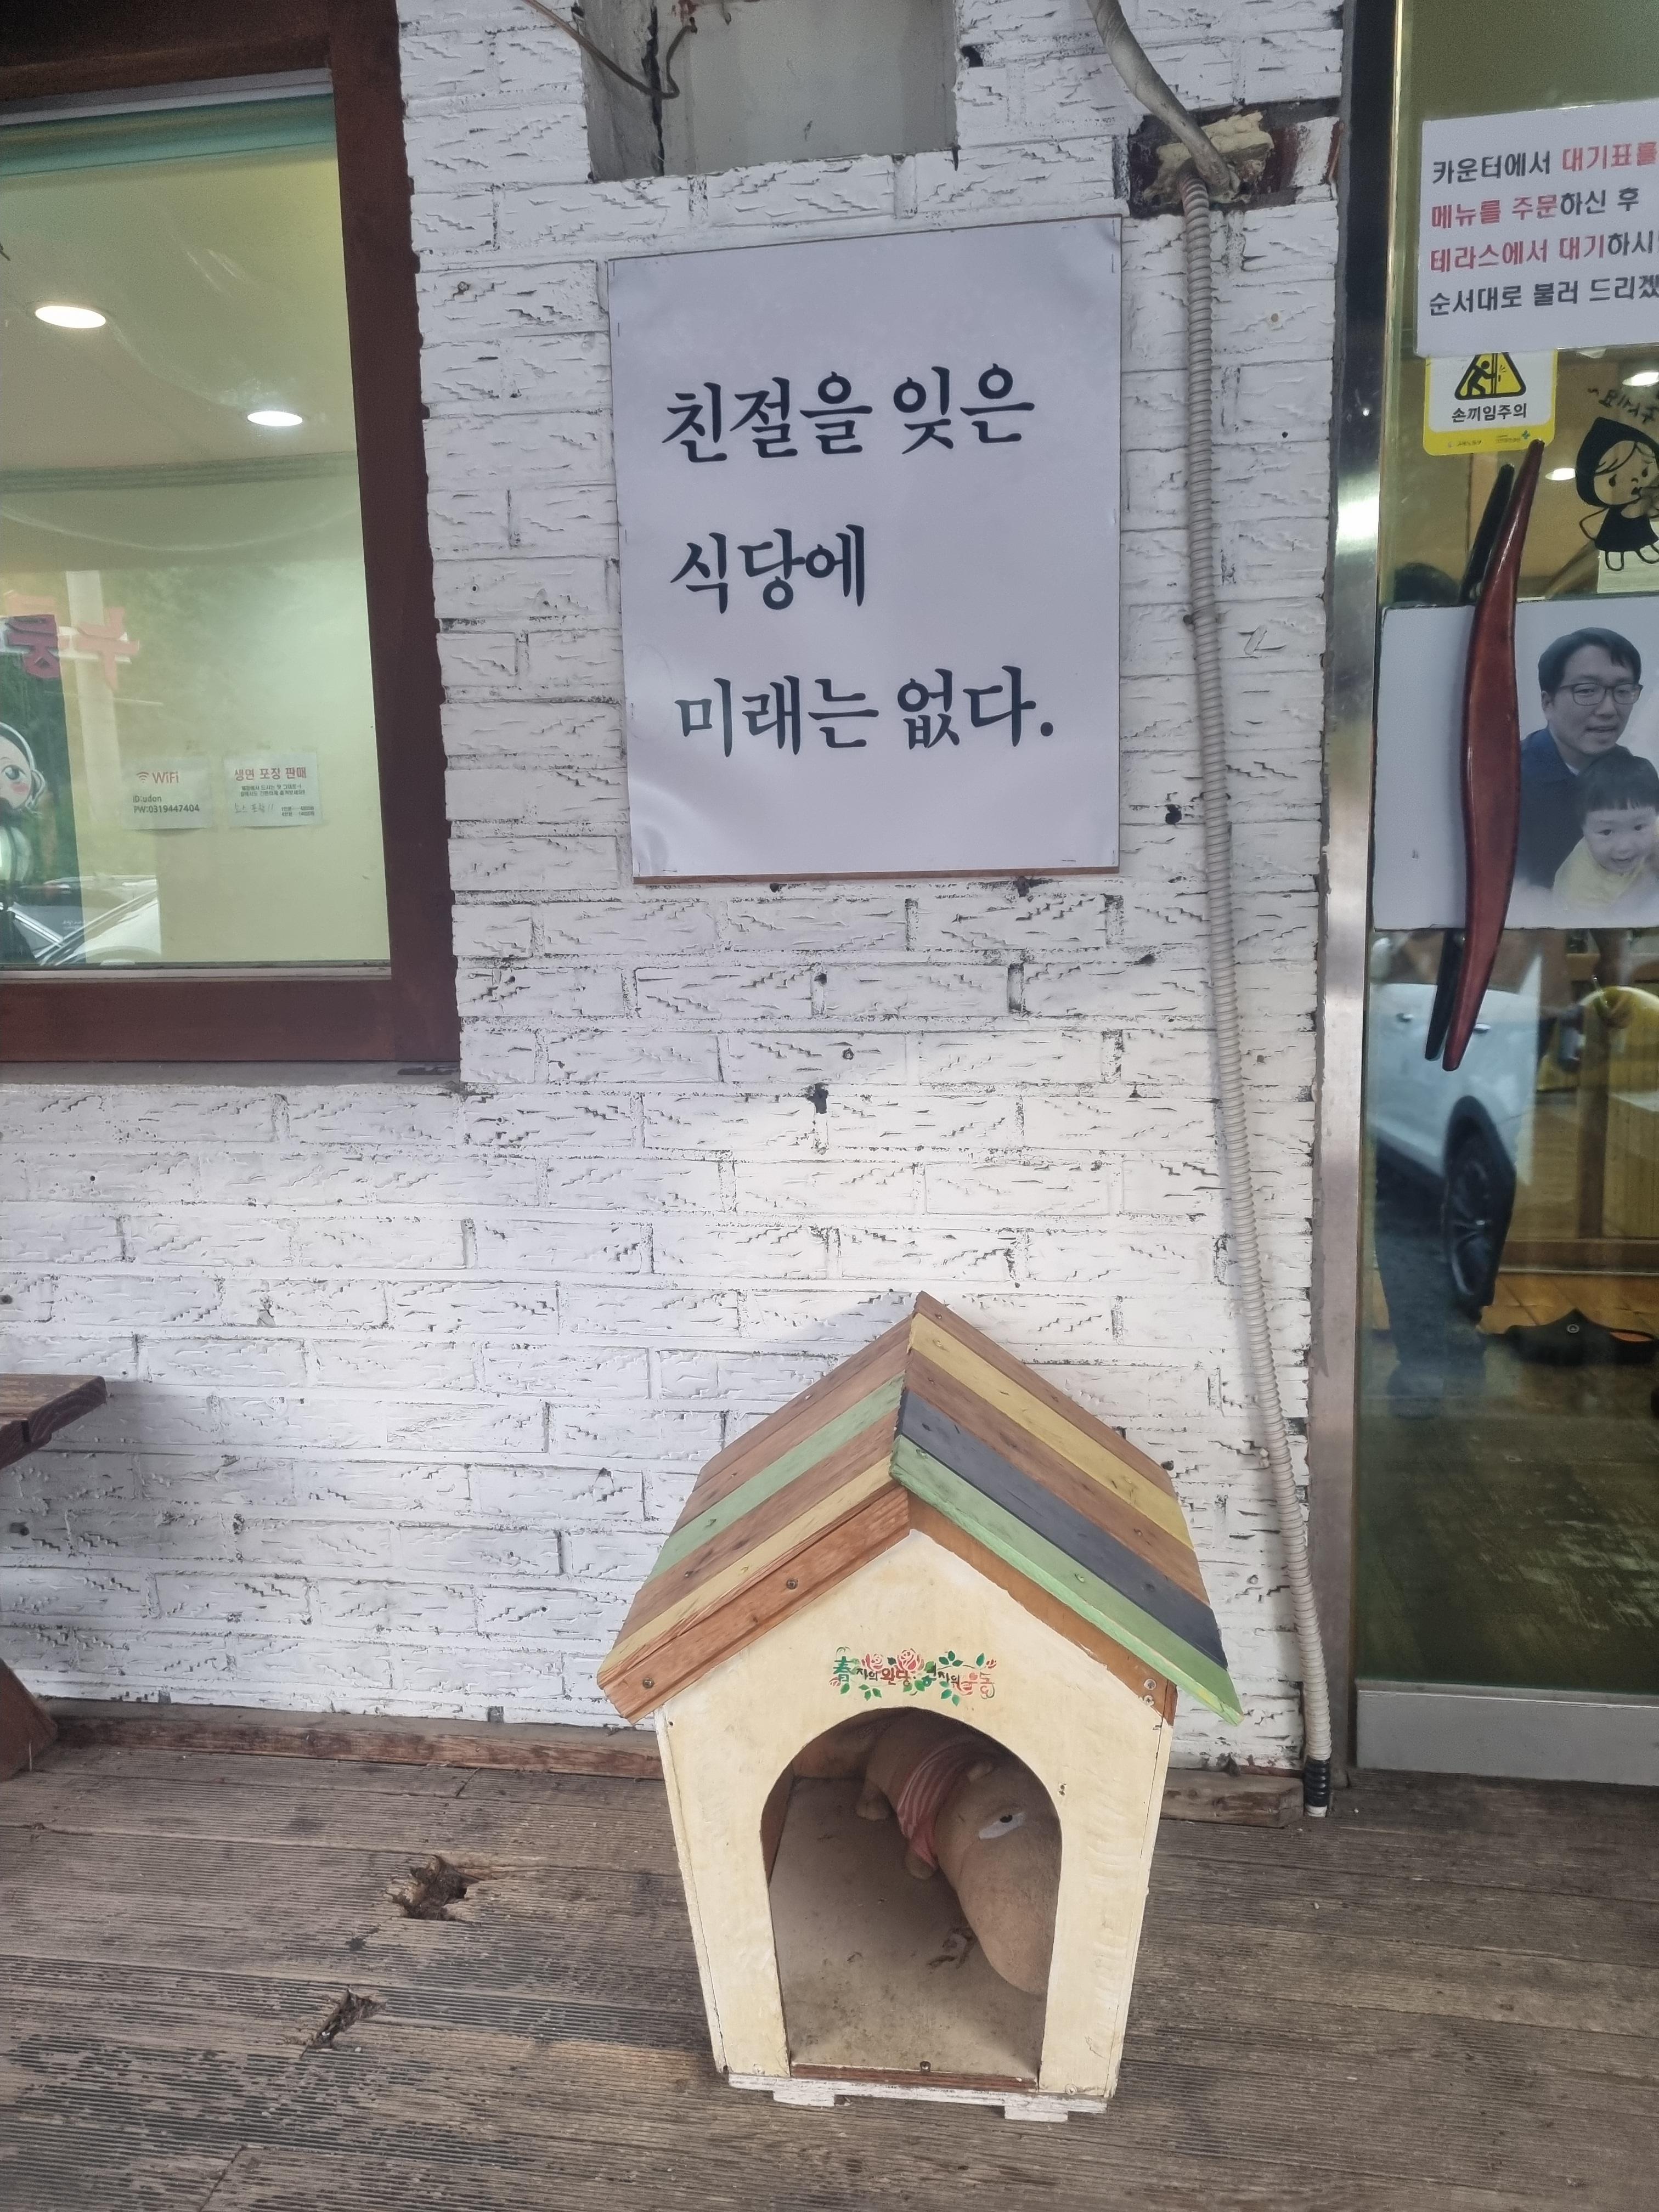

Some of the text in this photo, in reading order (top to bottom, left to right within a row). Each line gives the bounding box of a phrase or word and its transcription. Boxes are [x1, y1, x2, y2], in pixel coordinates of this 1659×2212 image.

[1432, 141, 1658, 184] 카운터에서 대기표를
[1431, 187, 1639, 229] 메뉴를 주문하신 후
[1430, 230, 1659, 273] 테라스에서 대기하시
[1429, 285, 1522, 317] 순서대로
[1533, 280, 1579, 307] 불러
[661, 362, 1036, 464] 친절을 잊은
[1451, 403, 1528, 424] 손끼임주의
[669, 523, 866, 614] 식당에
[674, 665, 1055, 758] 미래는 없다.
[151, 771, 179, 784] WiFi
[234, 766, 307, 782] 생면 포장 판매
[133, 794, 162, 804] ID:udon
[133, 804, 200, 814] PW:0319447404
